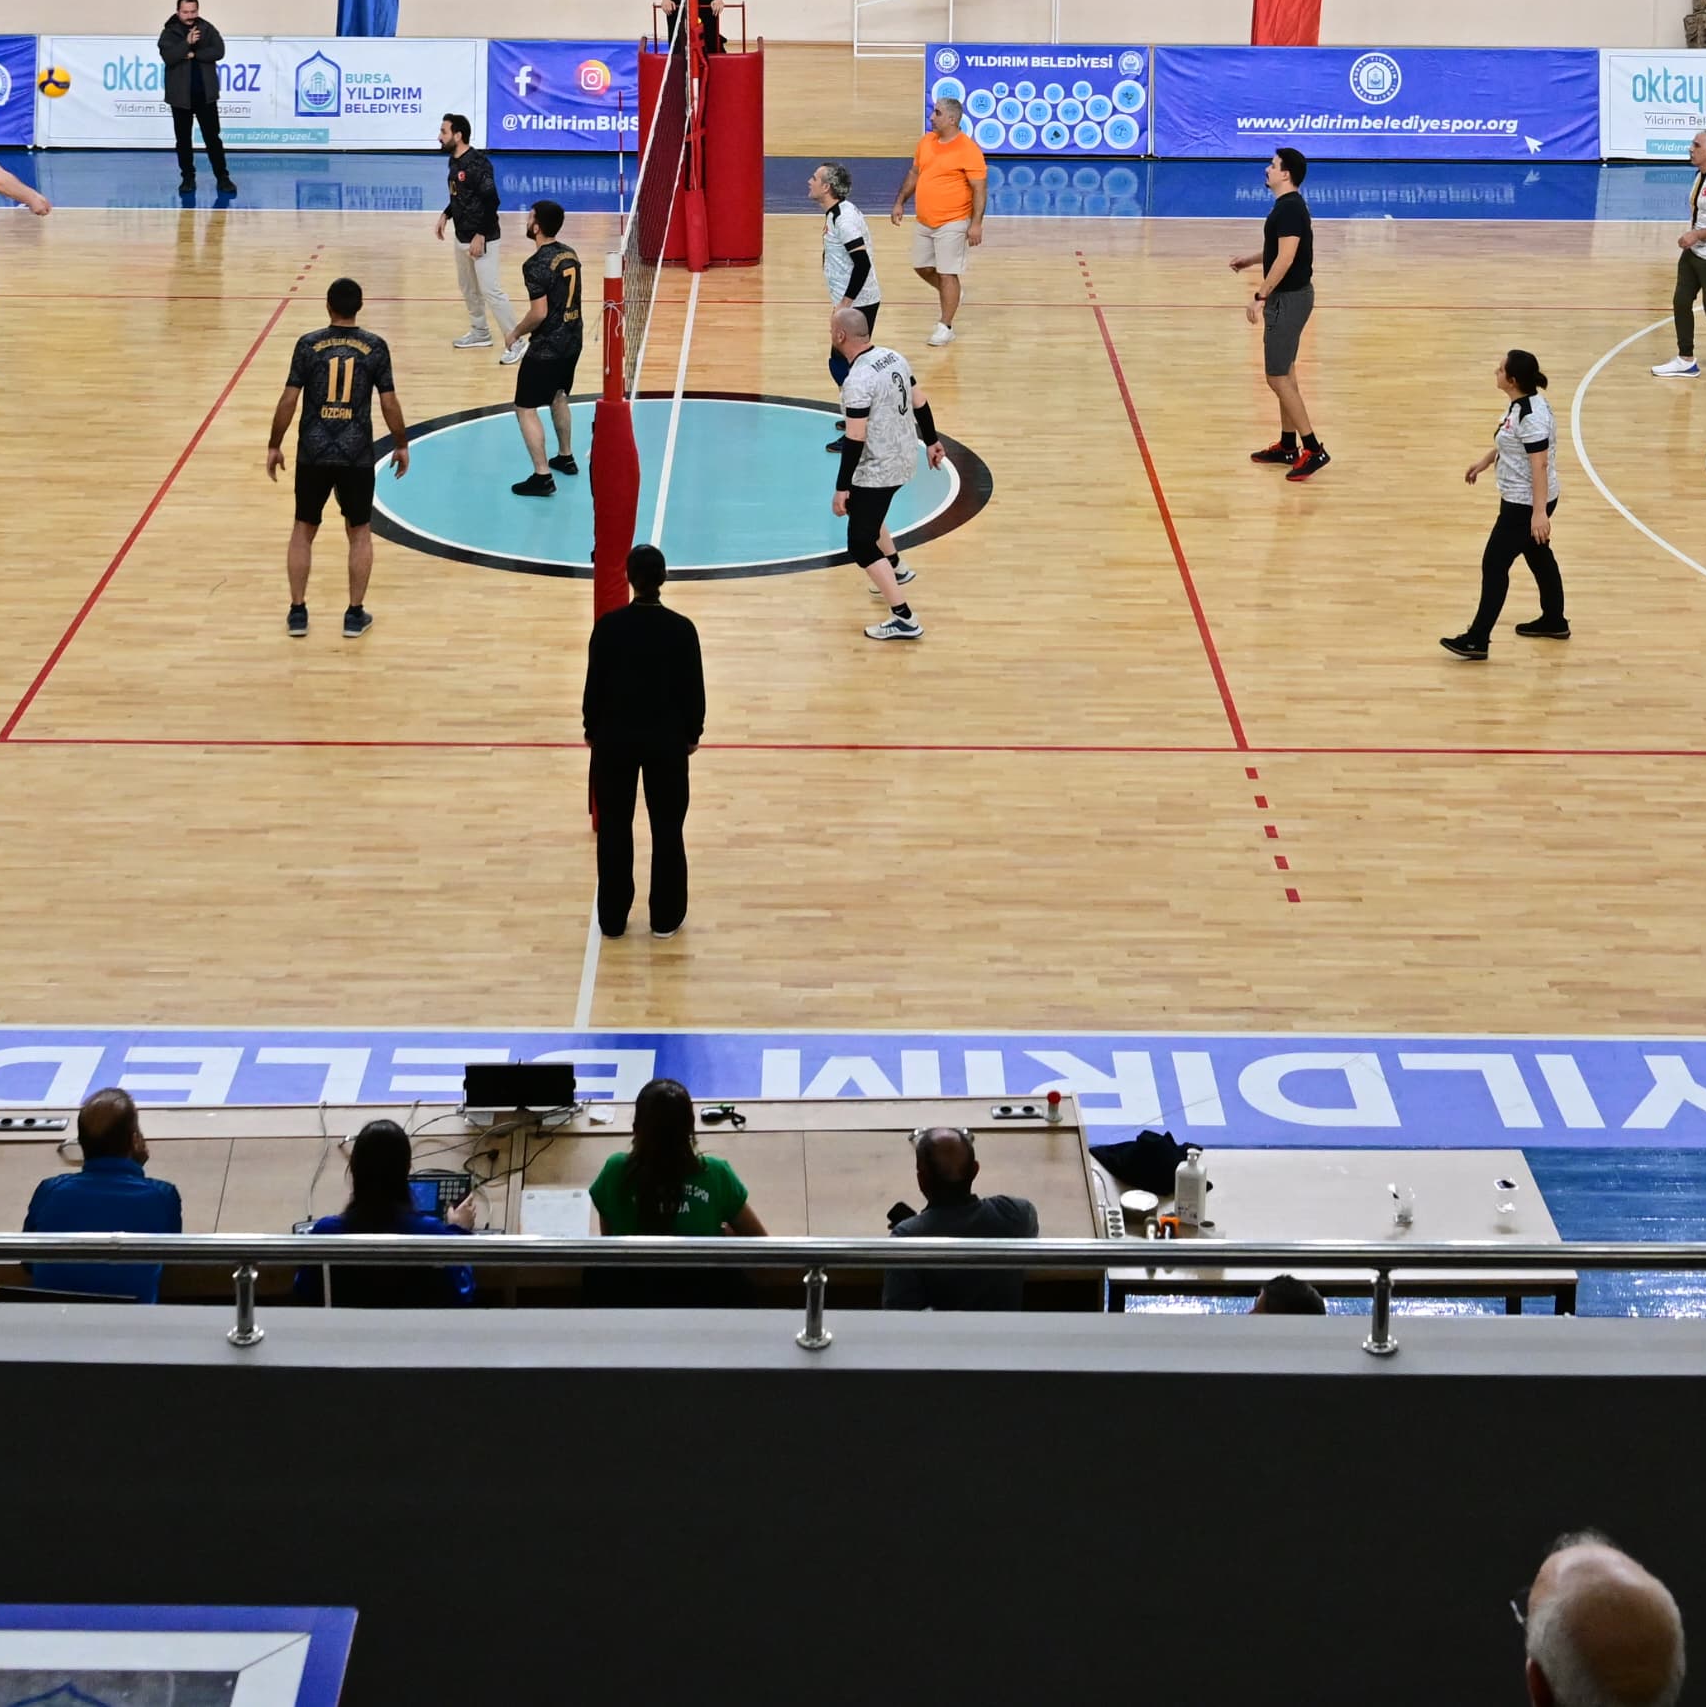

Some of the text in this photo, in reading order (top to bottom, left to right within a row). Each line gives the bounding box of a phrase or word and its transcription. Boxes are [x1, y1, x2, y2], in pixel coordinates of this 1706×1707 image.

[965, 54, 1029, 68] YILDIRIM
[1030, 53, 1114, 69] BELEDİYESİ
[344, 72, 392, 85] BURSA
[345, 86, 423, 101] YILDIRIM
[114, 103, 156, 114] Yıldırım
[217, 105, 252, 117] aşkanı
[344, 100, 423, 115] BELEDİYESİ
[501, 113, 640, 132] @YildirimBldS
[1235, 114, 1519, 134] www.yildirimbelediyespor.org
[1644, 114, 1686, 126] Yıldırım
[246, 131, 279, 141] sizinle
[562, 266, 577, 309] 7
[326, 355, 356, 404] 11
[891, 371, 909, 416] 3
